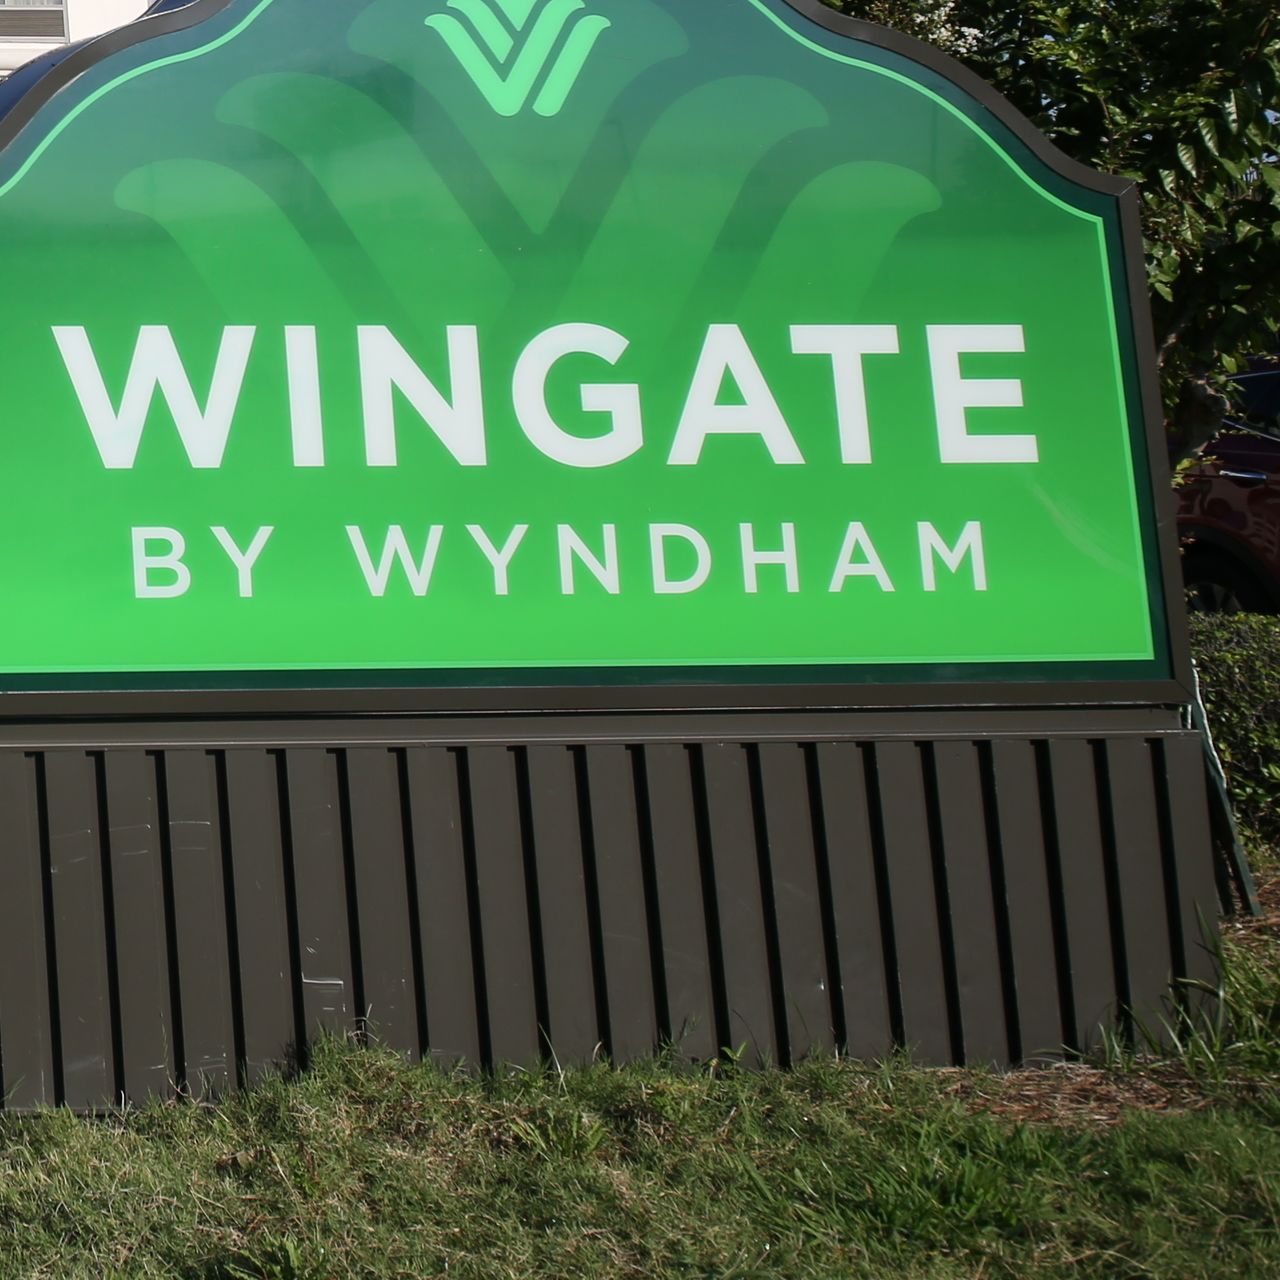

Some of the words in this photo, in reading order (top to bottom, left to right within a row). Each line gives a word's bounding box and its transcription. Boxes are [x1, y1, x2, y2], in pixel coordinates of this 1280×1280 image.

[51, 322, 1040, 469] WINGATE
[131, 525, 275, 599] BY
[344, 521, 988, 597] WYNDHAM
